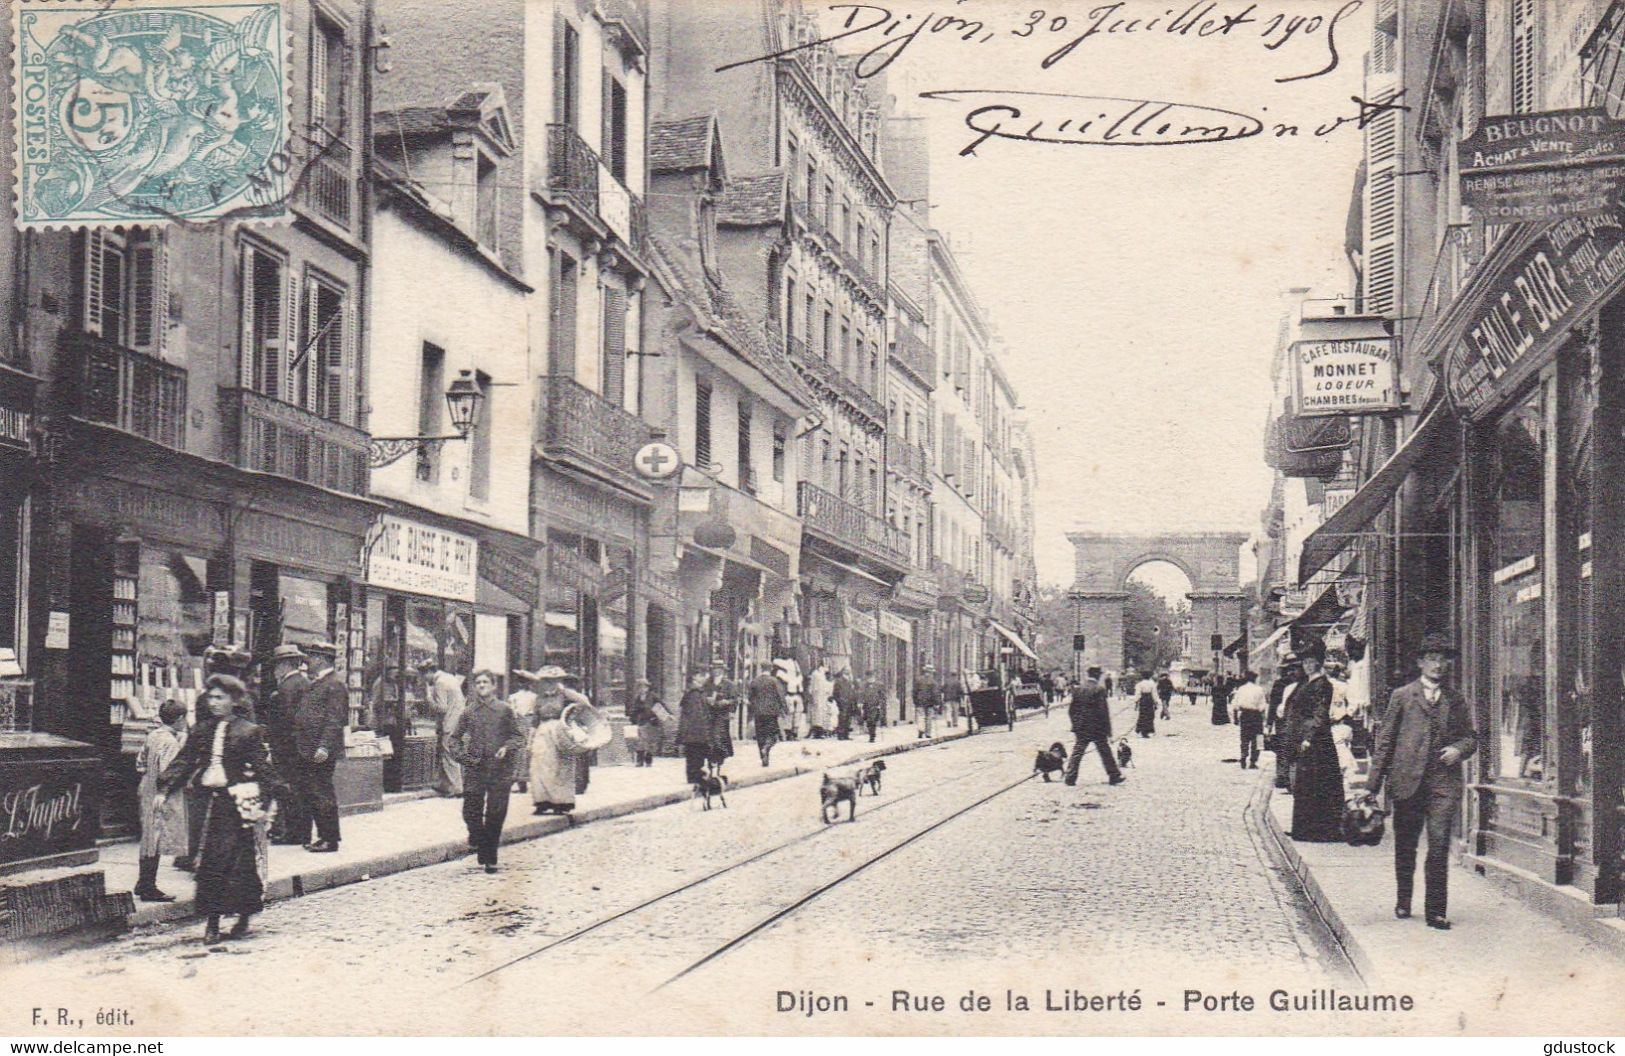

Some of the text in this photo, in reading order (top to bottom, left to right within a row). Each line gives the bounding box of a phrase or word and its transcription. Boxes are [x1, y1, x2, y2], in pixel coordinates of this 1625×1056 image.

[1012, 10, 1066, 37] 30
[1041, 1, 1257, 69] Juillet
[24, 68, 48, 161] POSTES
[1485, 114, 1604, 143] BEUGNOT
[1488, 196, 1611, 218] CONTENTIEUX
[1313, 362, 1378, 378] MONNET
[1316, 379, 1376, 391] LOGEUR
[1303, 394, 1357, 406] CHAMBRES
